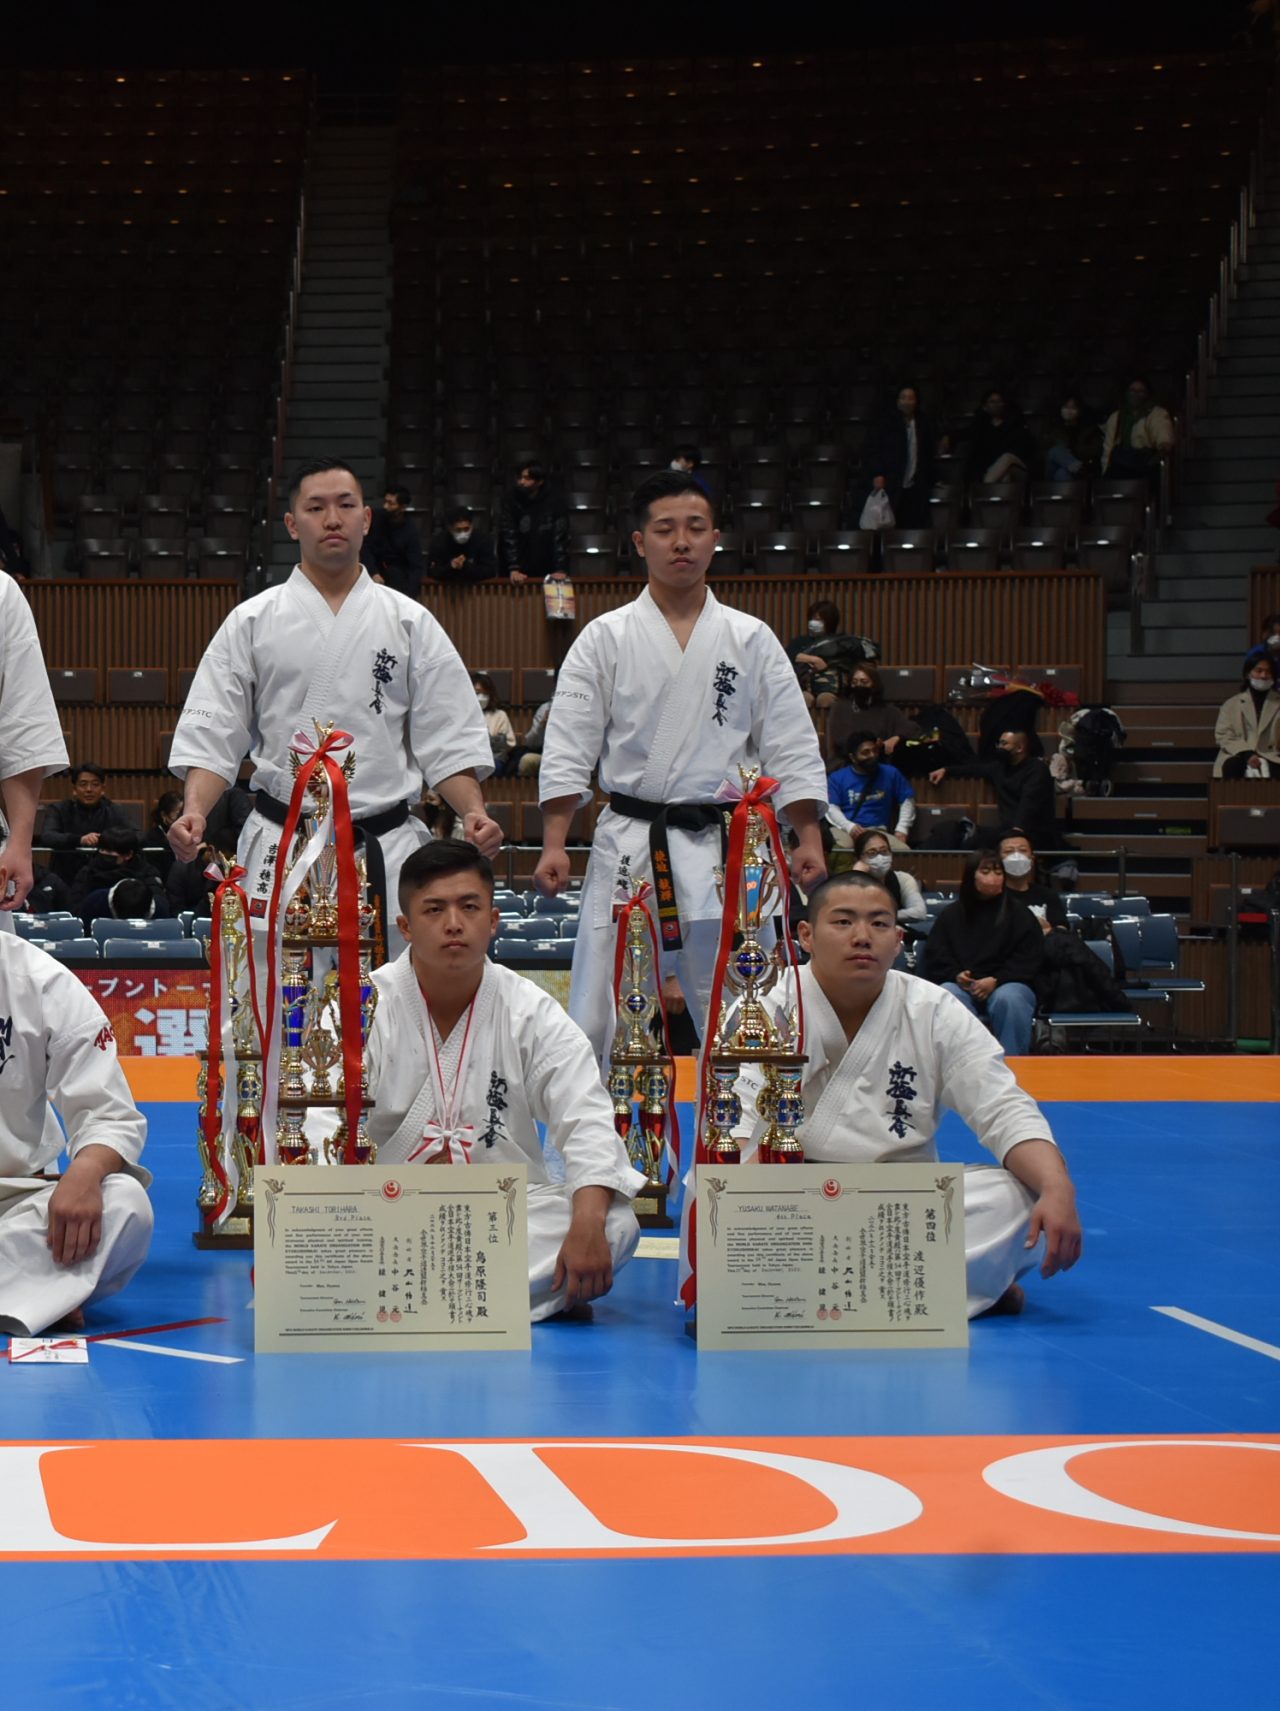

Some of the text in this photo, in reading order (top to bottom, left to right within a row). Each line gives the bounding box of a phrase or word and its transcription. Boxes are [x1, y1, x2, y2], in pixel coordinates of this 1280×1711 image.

[93, 1026, 114, 1052] MA
[487, 1210, 499, 1244] 第三位
[924, 1208, 937, 1242] 第四位
